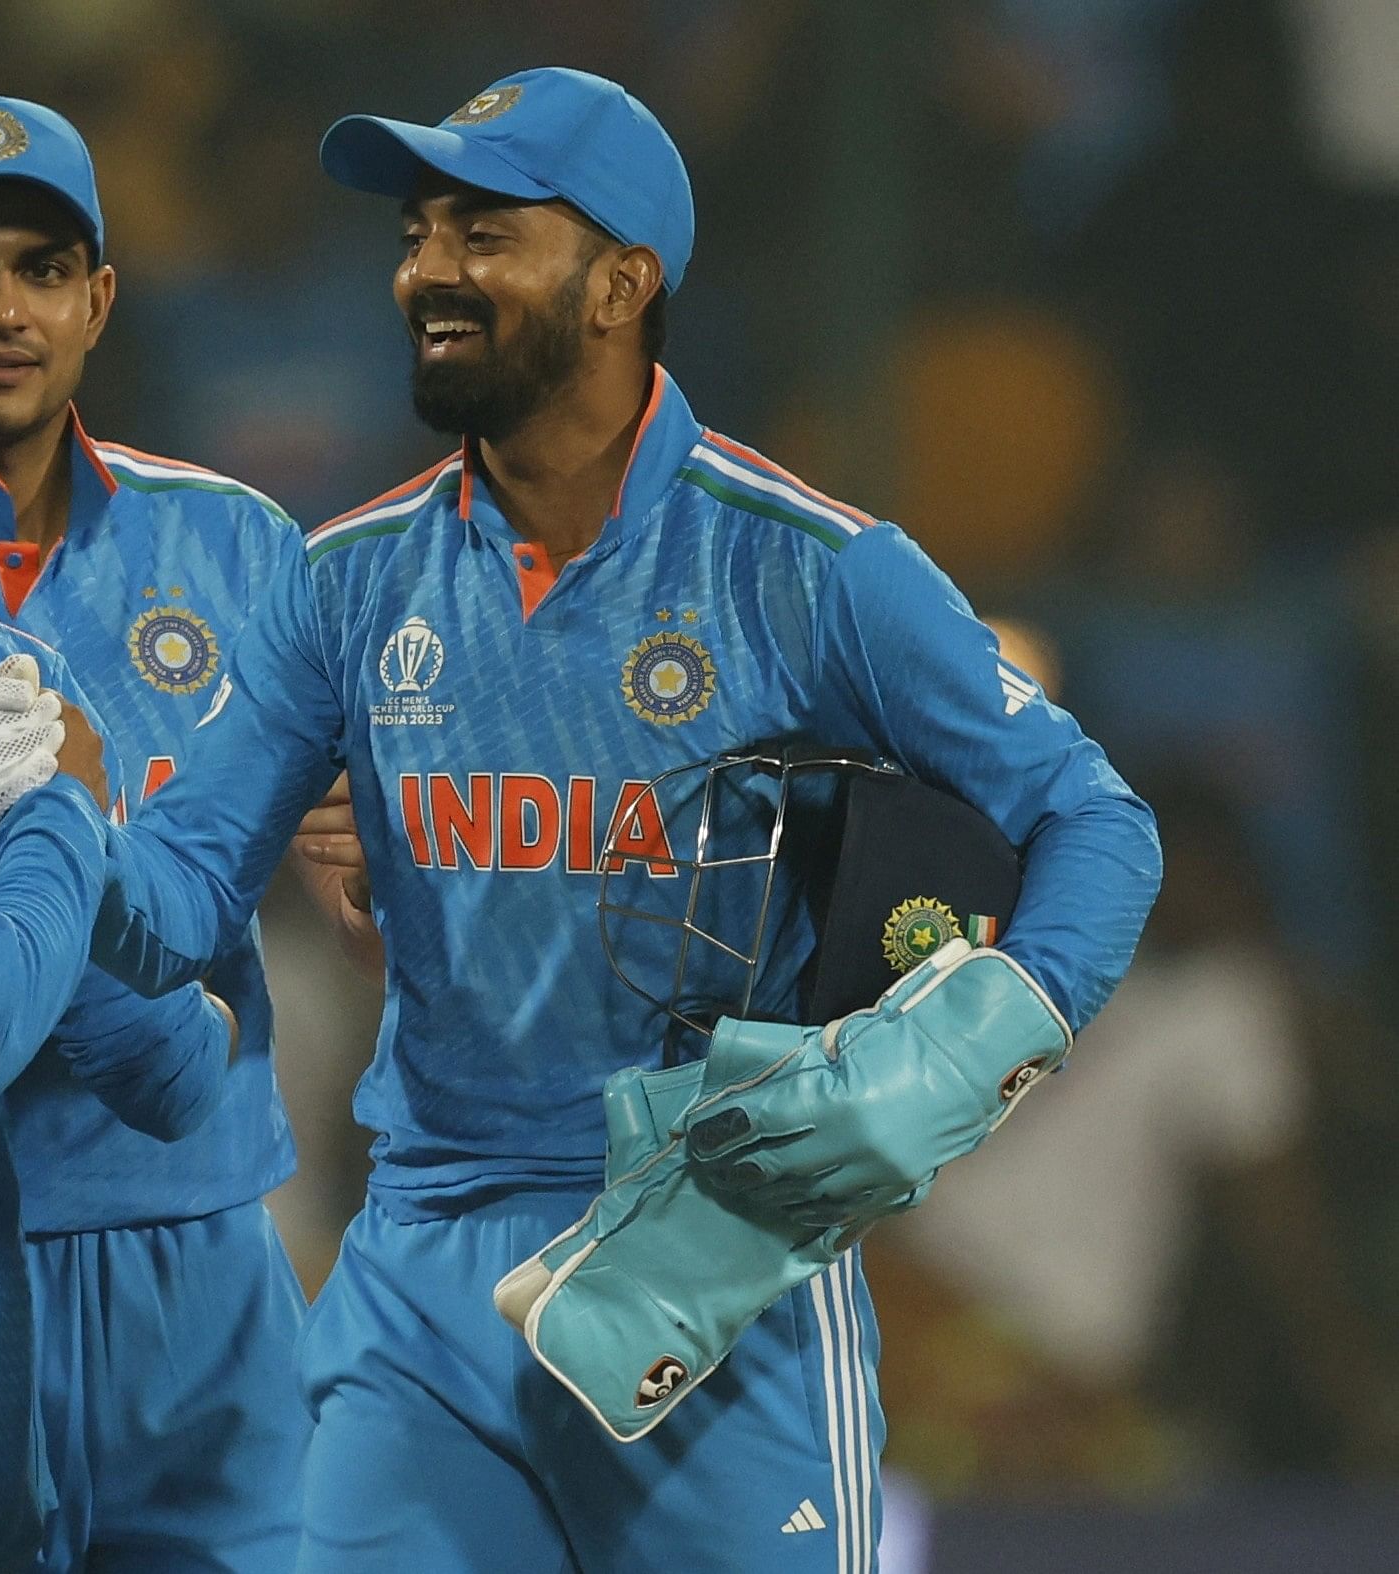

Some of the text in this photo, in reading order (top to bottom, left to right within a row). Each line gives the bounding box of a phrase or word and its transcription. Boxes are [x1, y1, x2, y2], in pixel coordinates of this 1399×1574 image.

[385, 696, 400, 705] ICC
[401, 704, 434, 713] WORLD
[435, 703, 455, 713] CUP
[371, 713, 443, 726] INDIA 2023
[400, 772, 679, 878] INDIA
